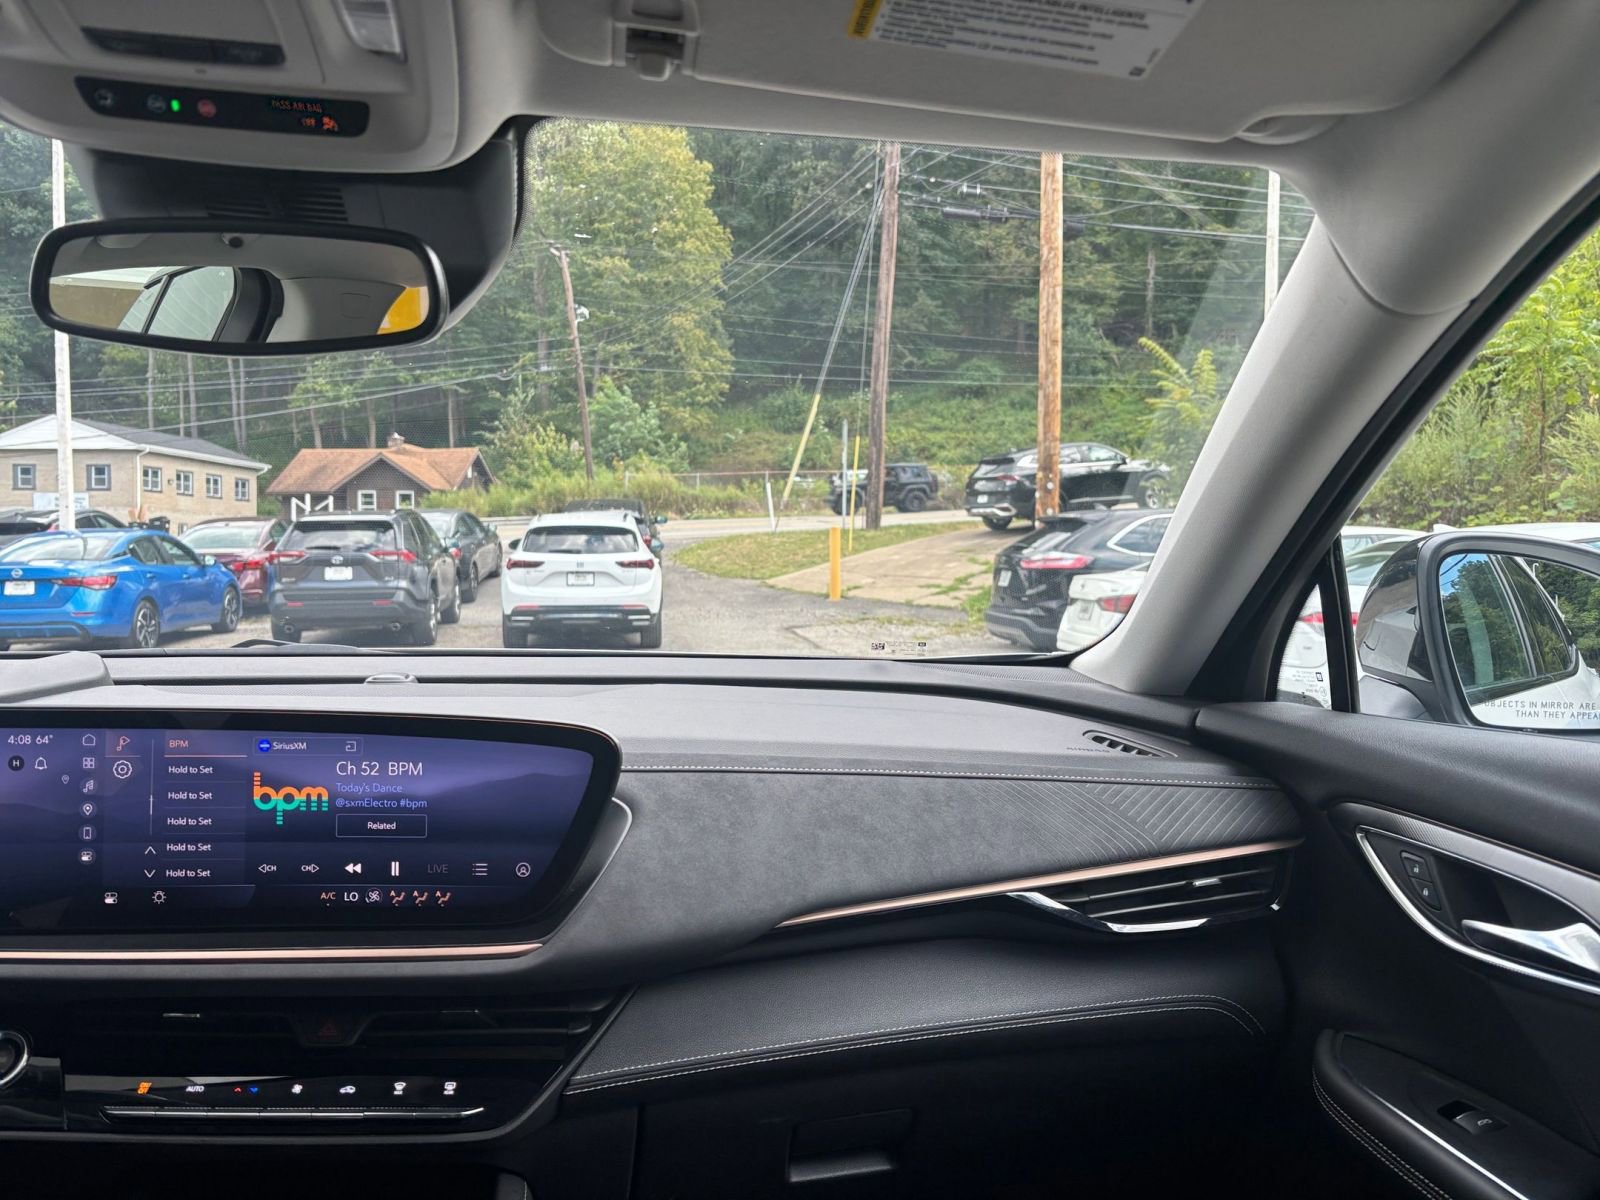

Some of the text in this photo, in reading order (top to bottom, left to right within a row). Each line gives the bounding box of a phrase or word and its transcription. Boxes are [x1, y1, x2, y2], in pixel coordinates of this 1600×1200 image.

[1529, 701, 1538, 709] IN
[1541, 702, 1574, 710] MIRROR
[1516, 709, 1600, 720] THAN THEY APPEA
[8, 734, 31, 744] 4:08
[169, 740, 189, 748] BPM
[273, 742, 307, 750] SiriusXM
[168, 766, 213, 774] Hold to Set
[336, 761, 423, 776] Ch 52 BPM
[336, 782, 403, 795] Today's Dance
[168, 792, 213, 800] Hold to Set
[254, 772, 329, 825] bpm
[336, 798, 427, 811] @sxmElectro #bpm
[167, 818, 212, 826] Hold to Set
[367, 821, 396, 830] Related
[166, 843, 212, 852] Hold to Set
[266, 864, 276, 872] CH
[301, 864, 312, 872] CH
[427, 864, 448, 873] LIVE
[166, 869, 211, 877] Hold to Set
[320, 891, 336, 900] A/C
[344, 892, 358, 901] LO
